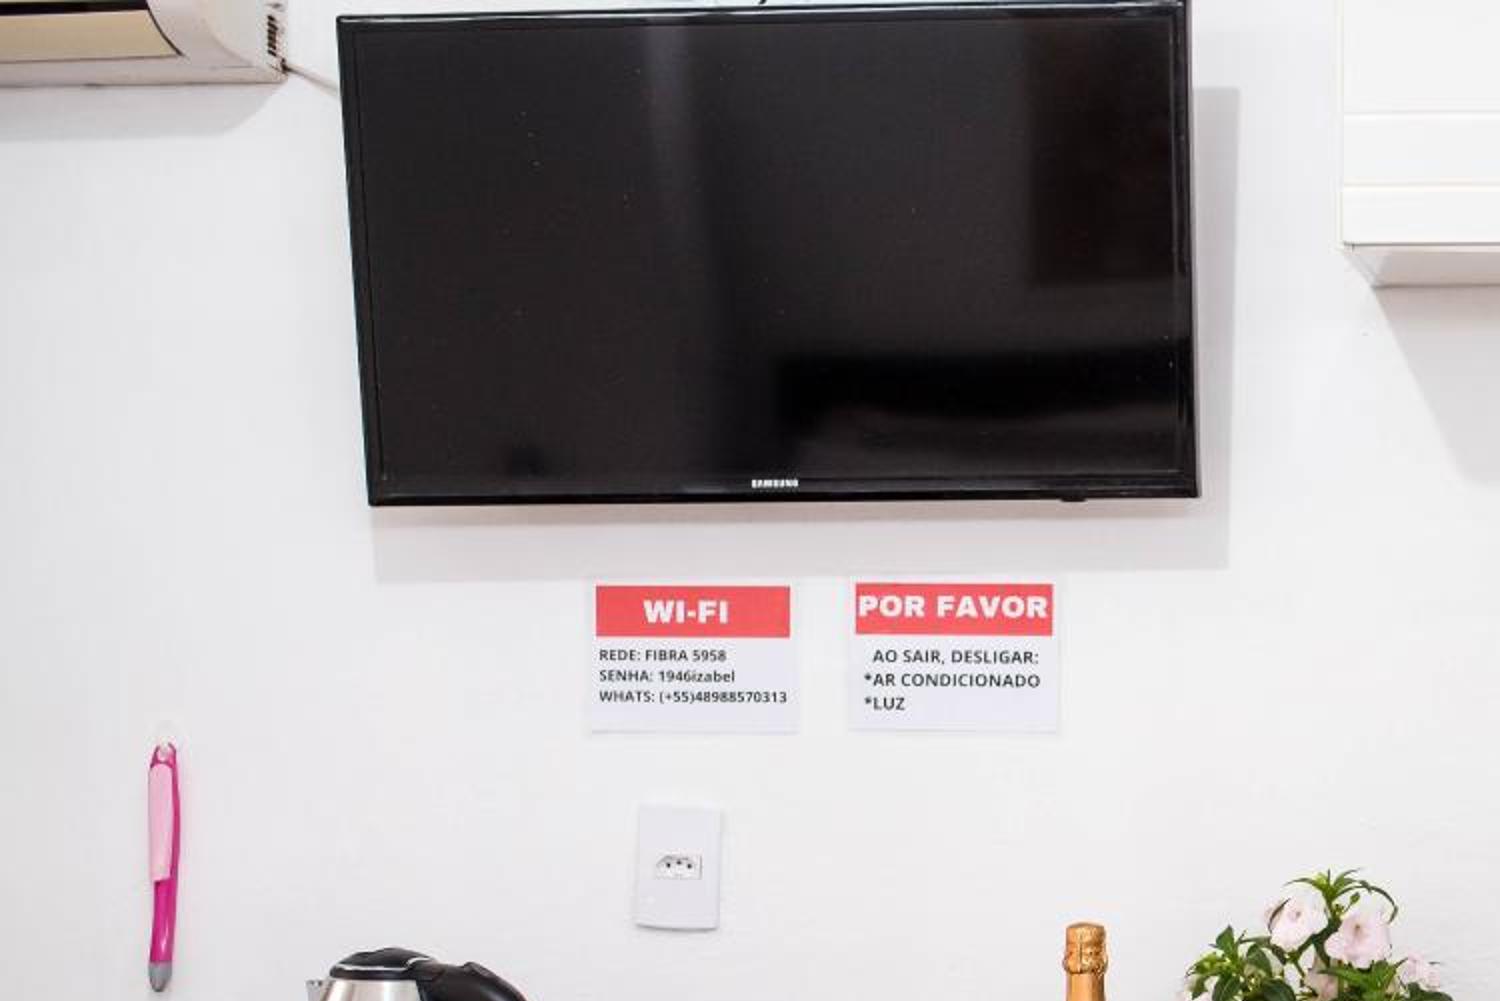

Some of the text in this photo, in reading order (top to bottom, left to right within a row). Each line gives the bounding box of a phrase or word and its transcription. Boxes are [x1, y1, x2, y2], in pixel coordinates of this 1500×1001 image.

[751, 479, 799, 488] SAMSUNG
[642, 599, 729, 624] WI-FI
[858, 594, 1048, 619] POR FAVOR
[599, 649, 727, 662] REDE: FIBRA 5958
[872, 649, 1039, 665] AO SAIR, DESLIGAR:
[599, 669, 735, 683] SENHA: 1946izabel
[901, 673, 1041, 688] CONDICIONADO
[599, 690, 655, 703] WHATS:
